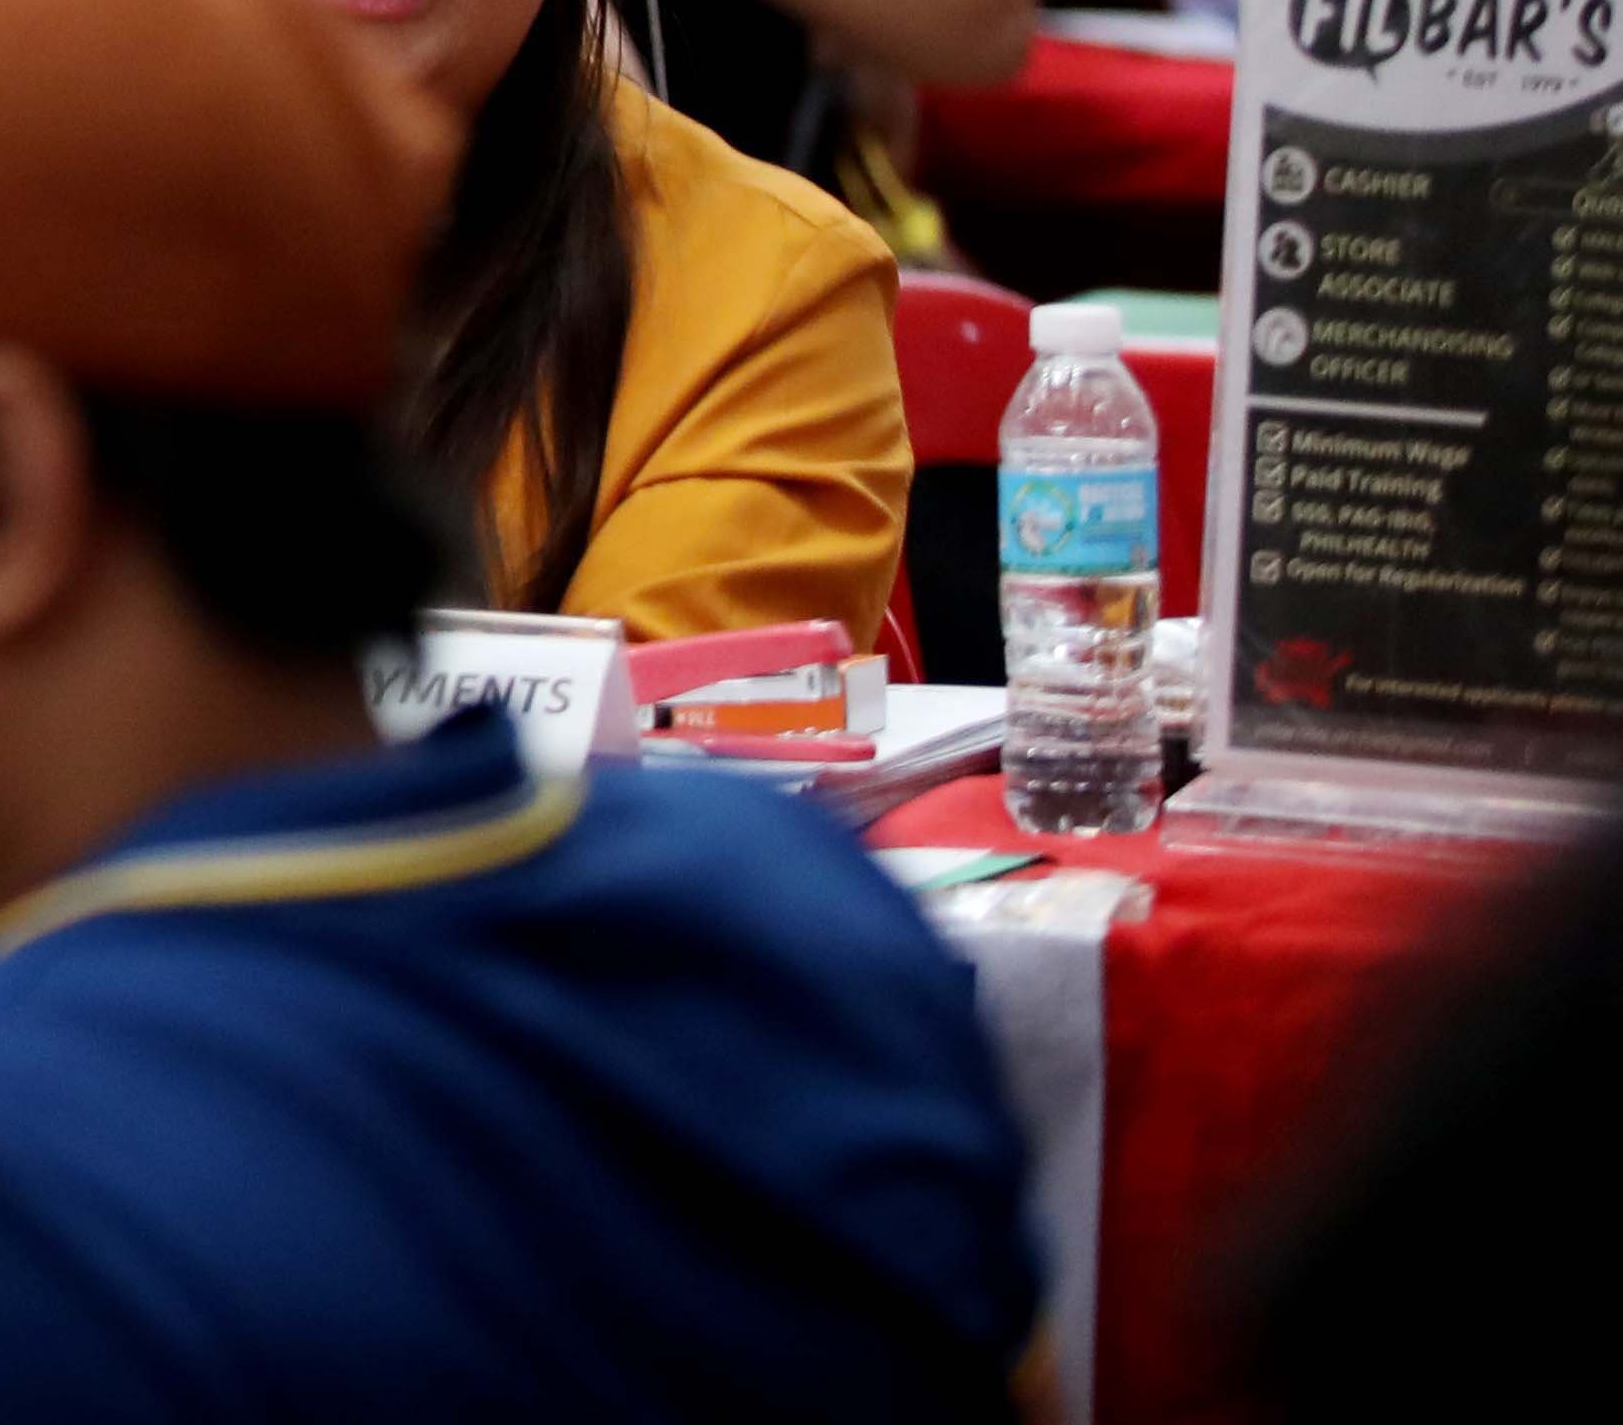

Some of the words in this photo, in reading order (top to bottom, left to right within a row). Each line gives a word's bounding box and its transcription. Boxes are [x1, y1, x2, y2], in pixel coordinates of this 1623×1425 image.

[1323, 166, 1431, 198] CASHIER
[1320, 232, 1402, 266] STORE
[1317, 271, 1455, 309] ASSOCIATE
[1313, 320, 1515, 361] MERCHANDISING
[1309, 353, 1409, 383] OFFICER
[1291, 429, 1403, 460] Minimum
[1406, 440, 1472, 469] Wage
[1291, 464, 1344, 491] Paid
[1346, 468, 1444, 504] Training
[1286, 557, 1343, 581] Open
[1344, 562, 1377, 582] for
[1380, 565, 1525, 596] Regularization
[370, 665, 574, 715] YMENTS
